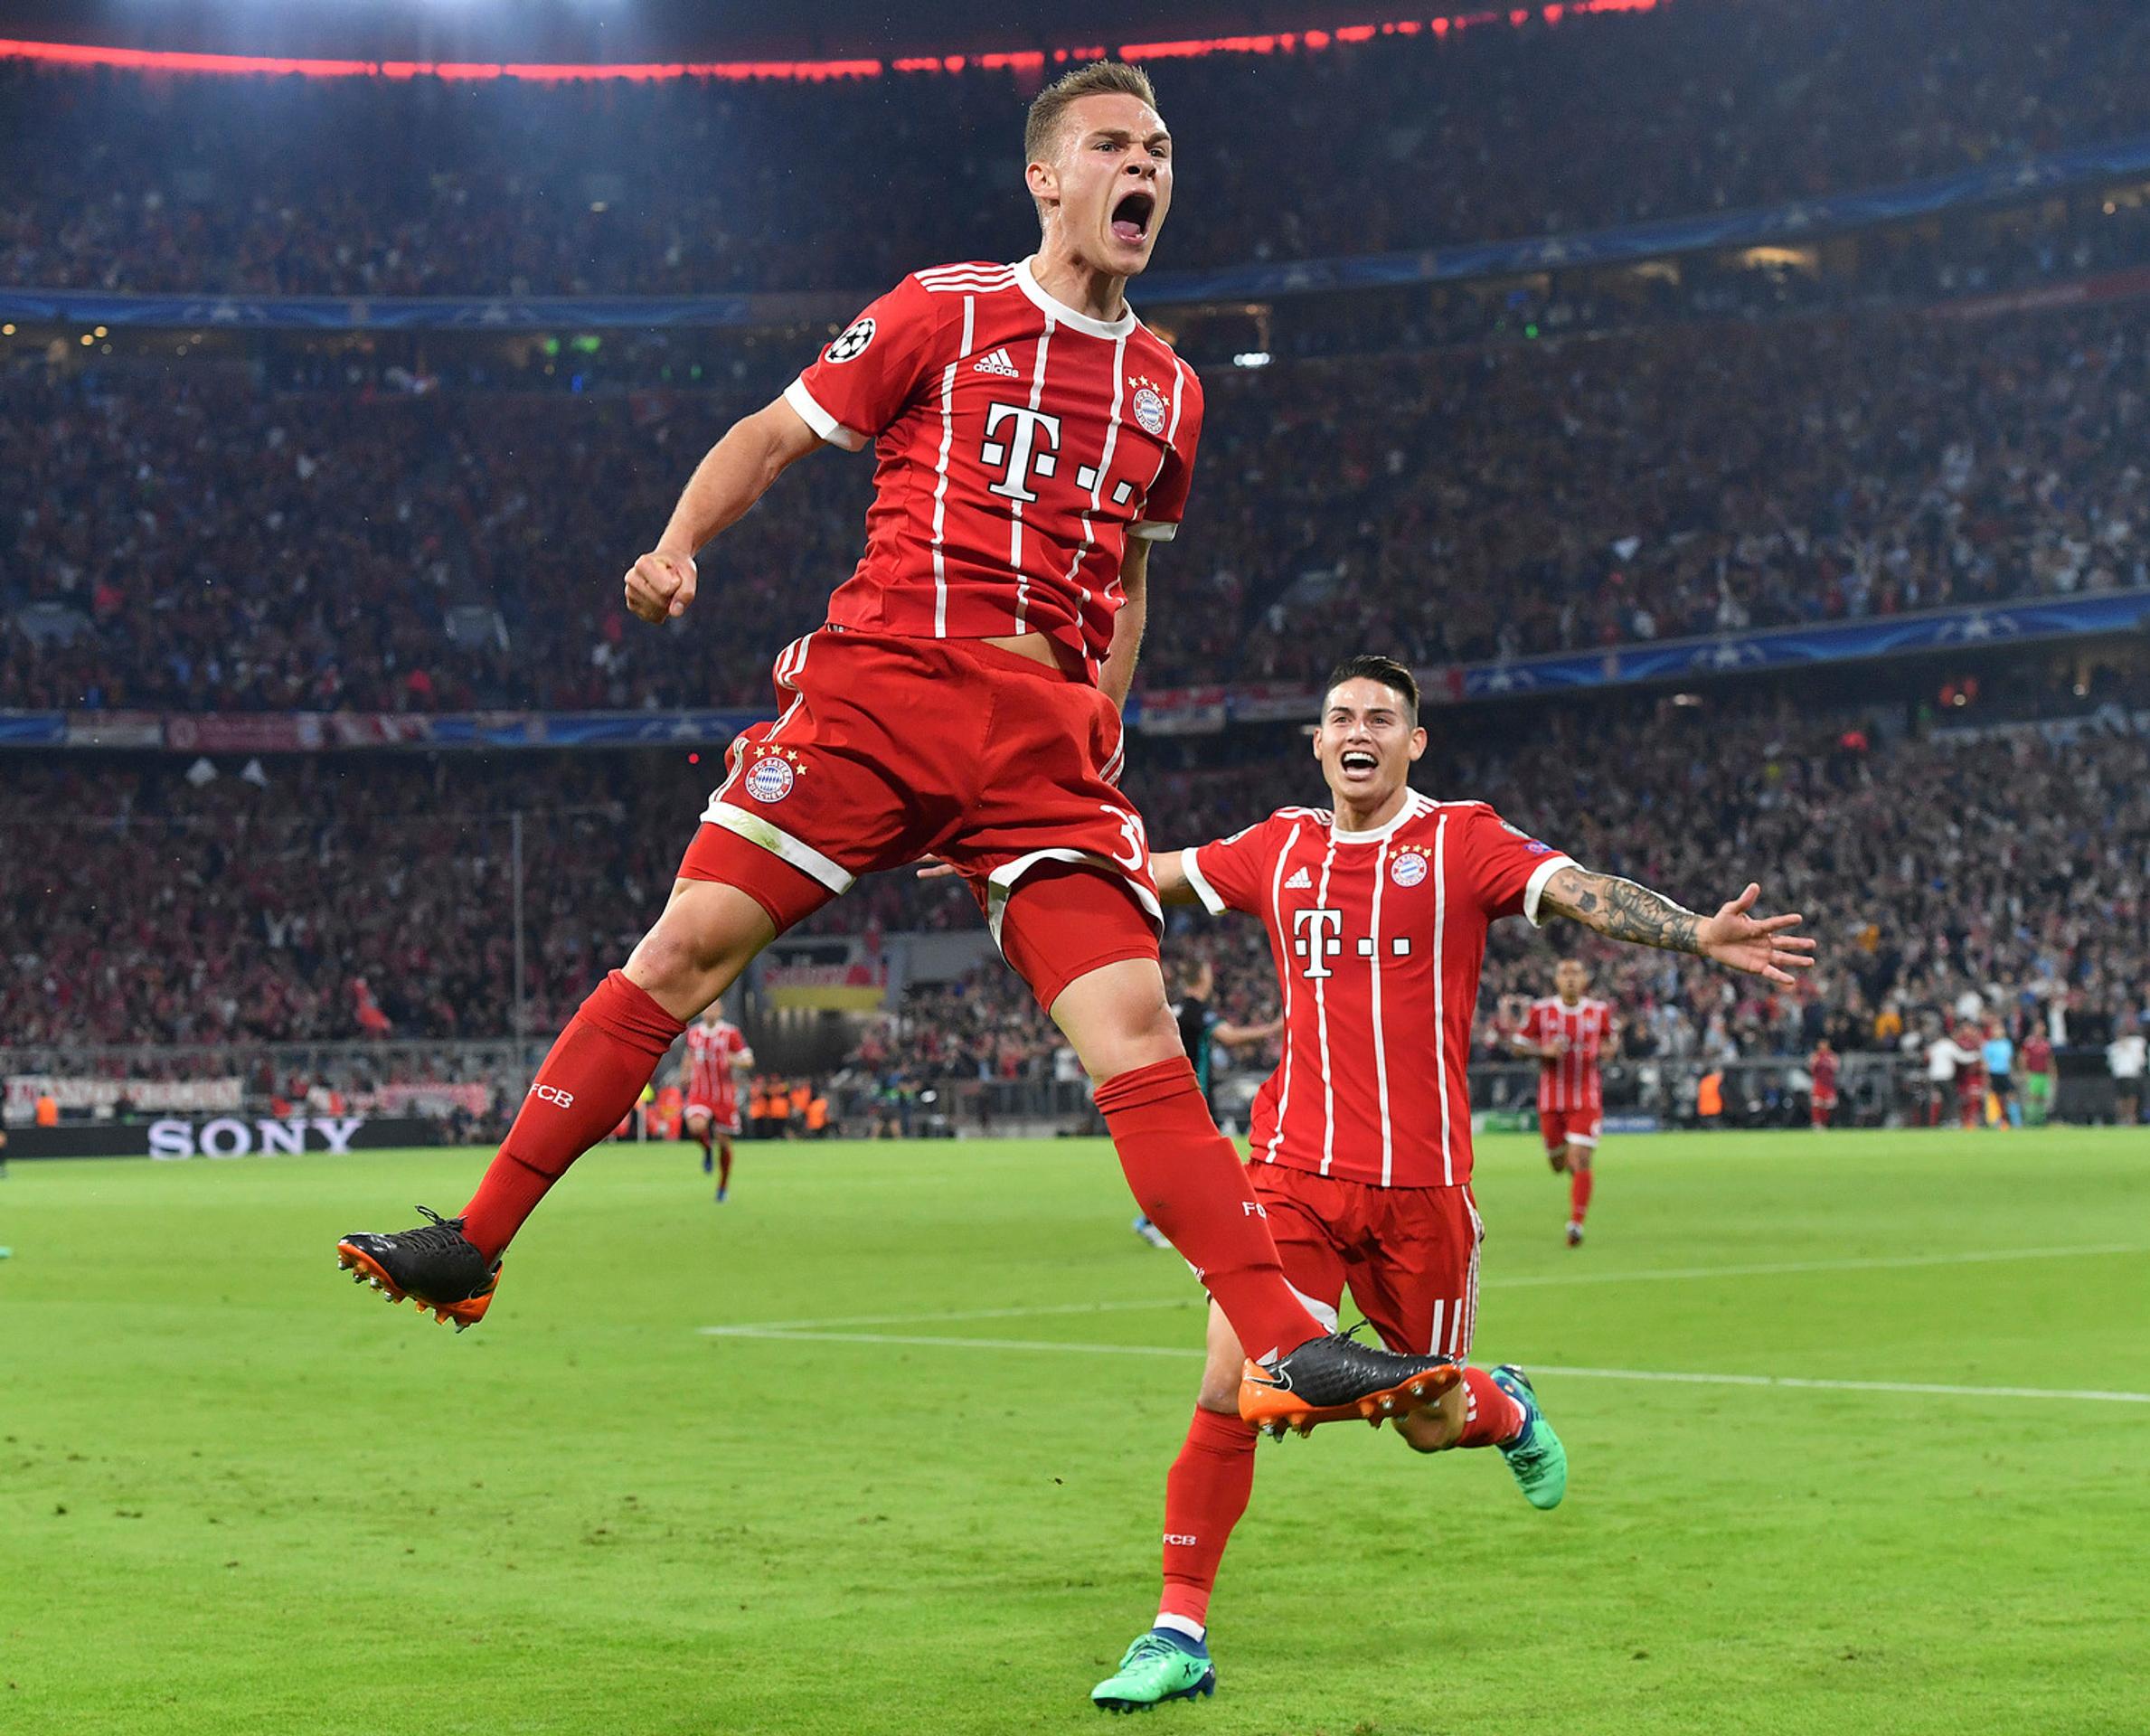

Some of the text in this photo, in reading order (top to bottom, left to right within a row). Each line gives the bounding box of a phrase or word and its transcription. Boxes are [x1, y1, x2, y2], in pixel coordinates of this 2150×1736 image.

[973, 363, 1020, 378] adidas
[985, 401, 1062, 503] T
[1293, 909, 1343, 978] T
[528, 1083, 574, 1109] FCB
[147, 1118, 362, 1160] SONY
